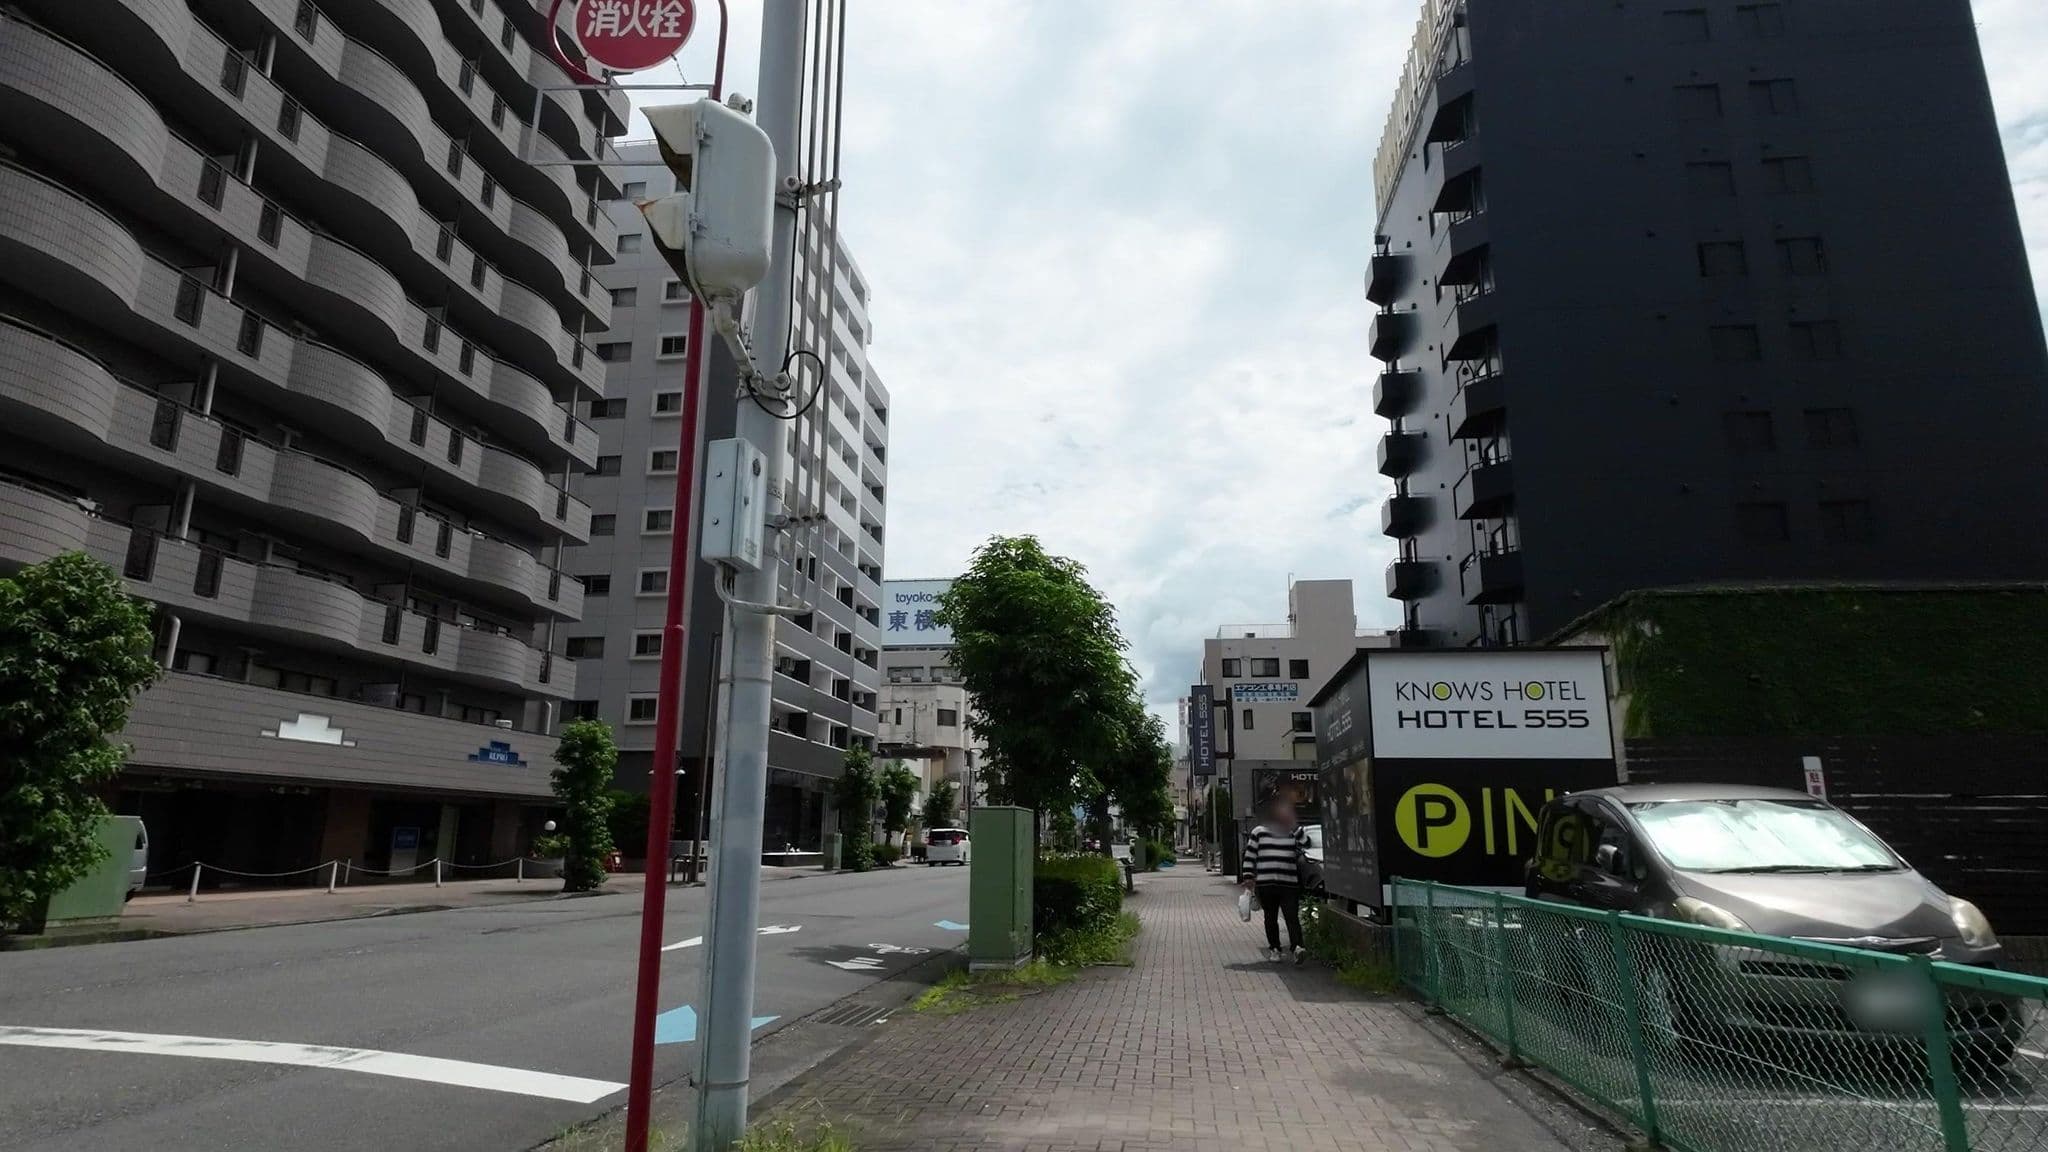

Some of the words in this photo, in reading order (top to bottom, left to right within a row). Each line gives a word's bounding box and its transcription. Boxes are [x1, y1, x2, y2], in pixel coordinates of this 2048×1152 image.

[585, 0, 686, 38] 消火栓
[1396, 681, 1493, 702] KNOWS
[1503, 681, 1586, 701] HOTEL
[1398, 710, 1518, 729] HOTEL
[1524, 710, 1590, 729] 555
[1414, 794, 1457, 849] P
